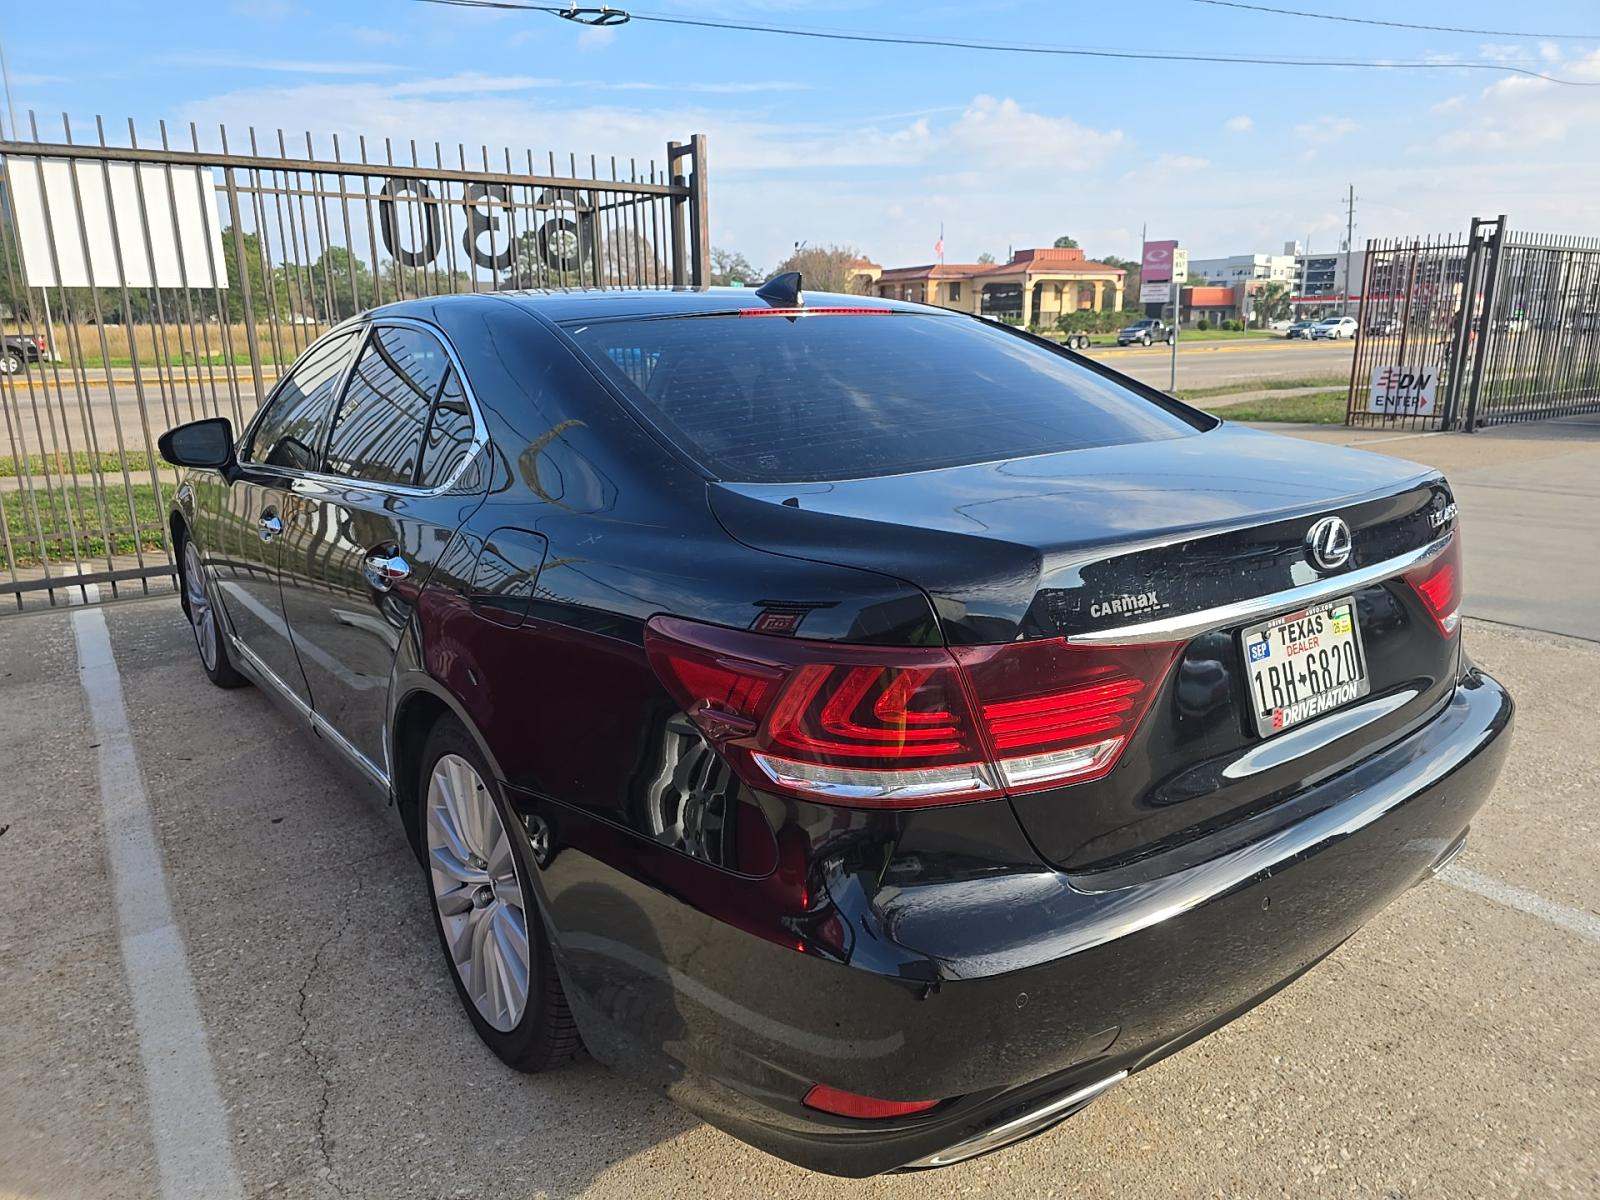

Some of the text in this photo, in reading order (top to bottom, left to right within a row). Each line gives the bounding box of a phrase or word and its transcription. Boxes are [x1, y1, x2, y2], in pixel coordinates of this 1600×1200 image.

[1278, 615, 1323, 645] TEXAS
[1251, 643, 1267, 658] SEP
[1286, 636, 1320, 657] DEALER
[1306, 641, 1357, 695] 6820
